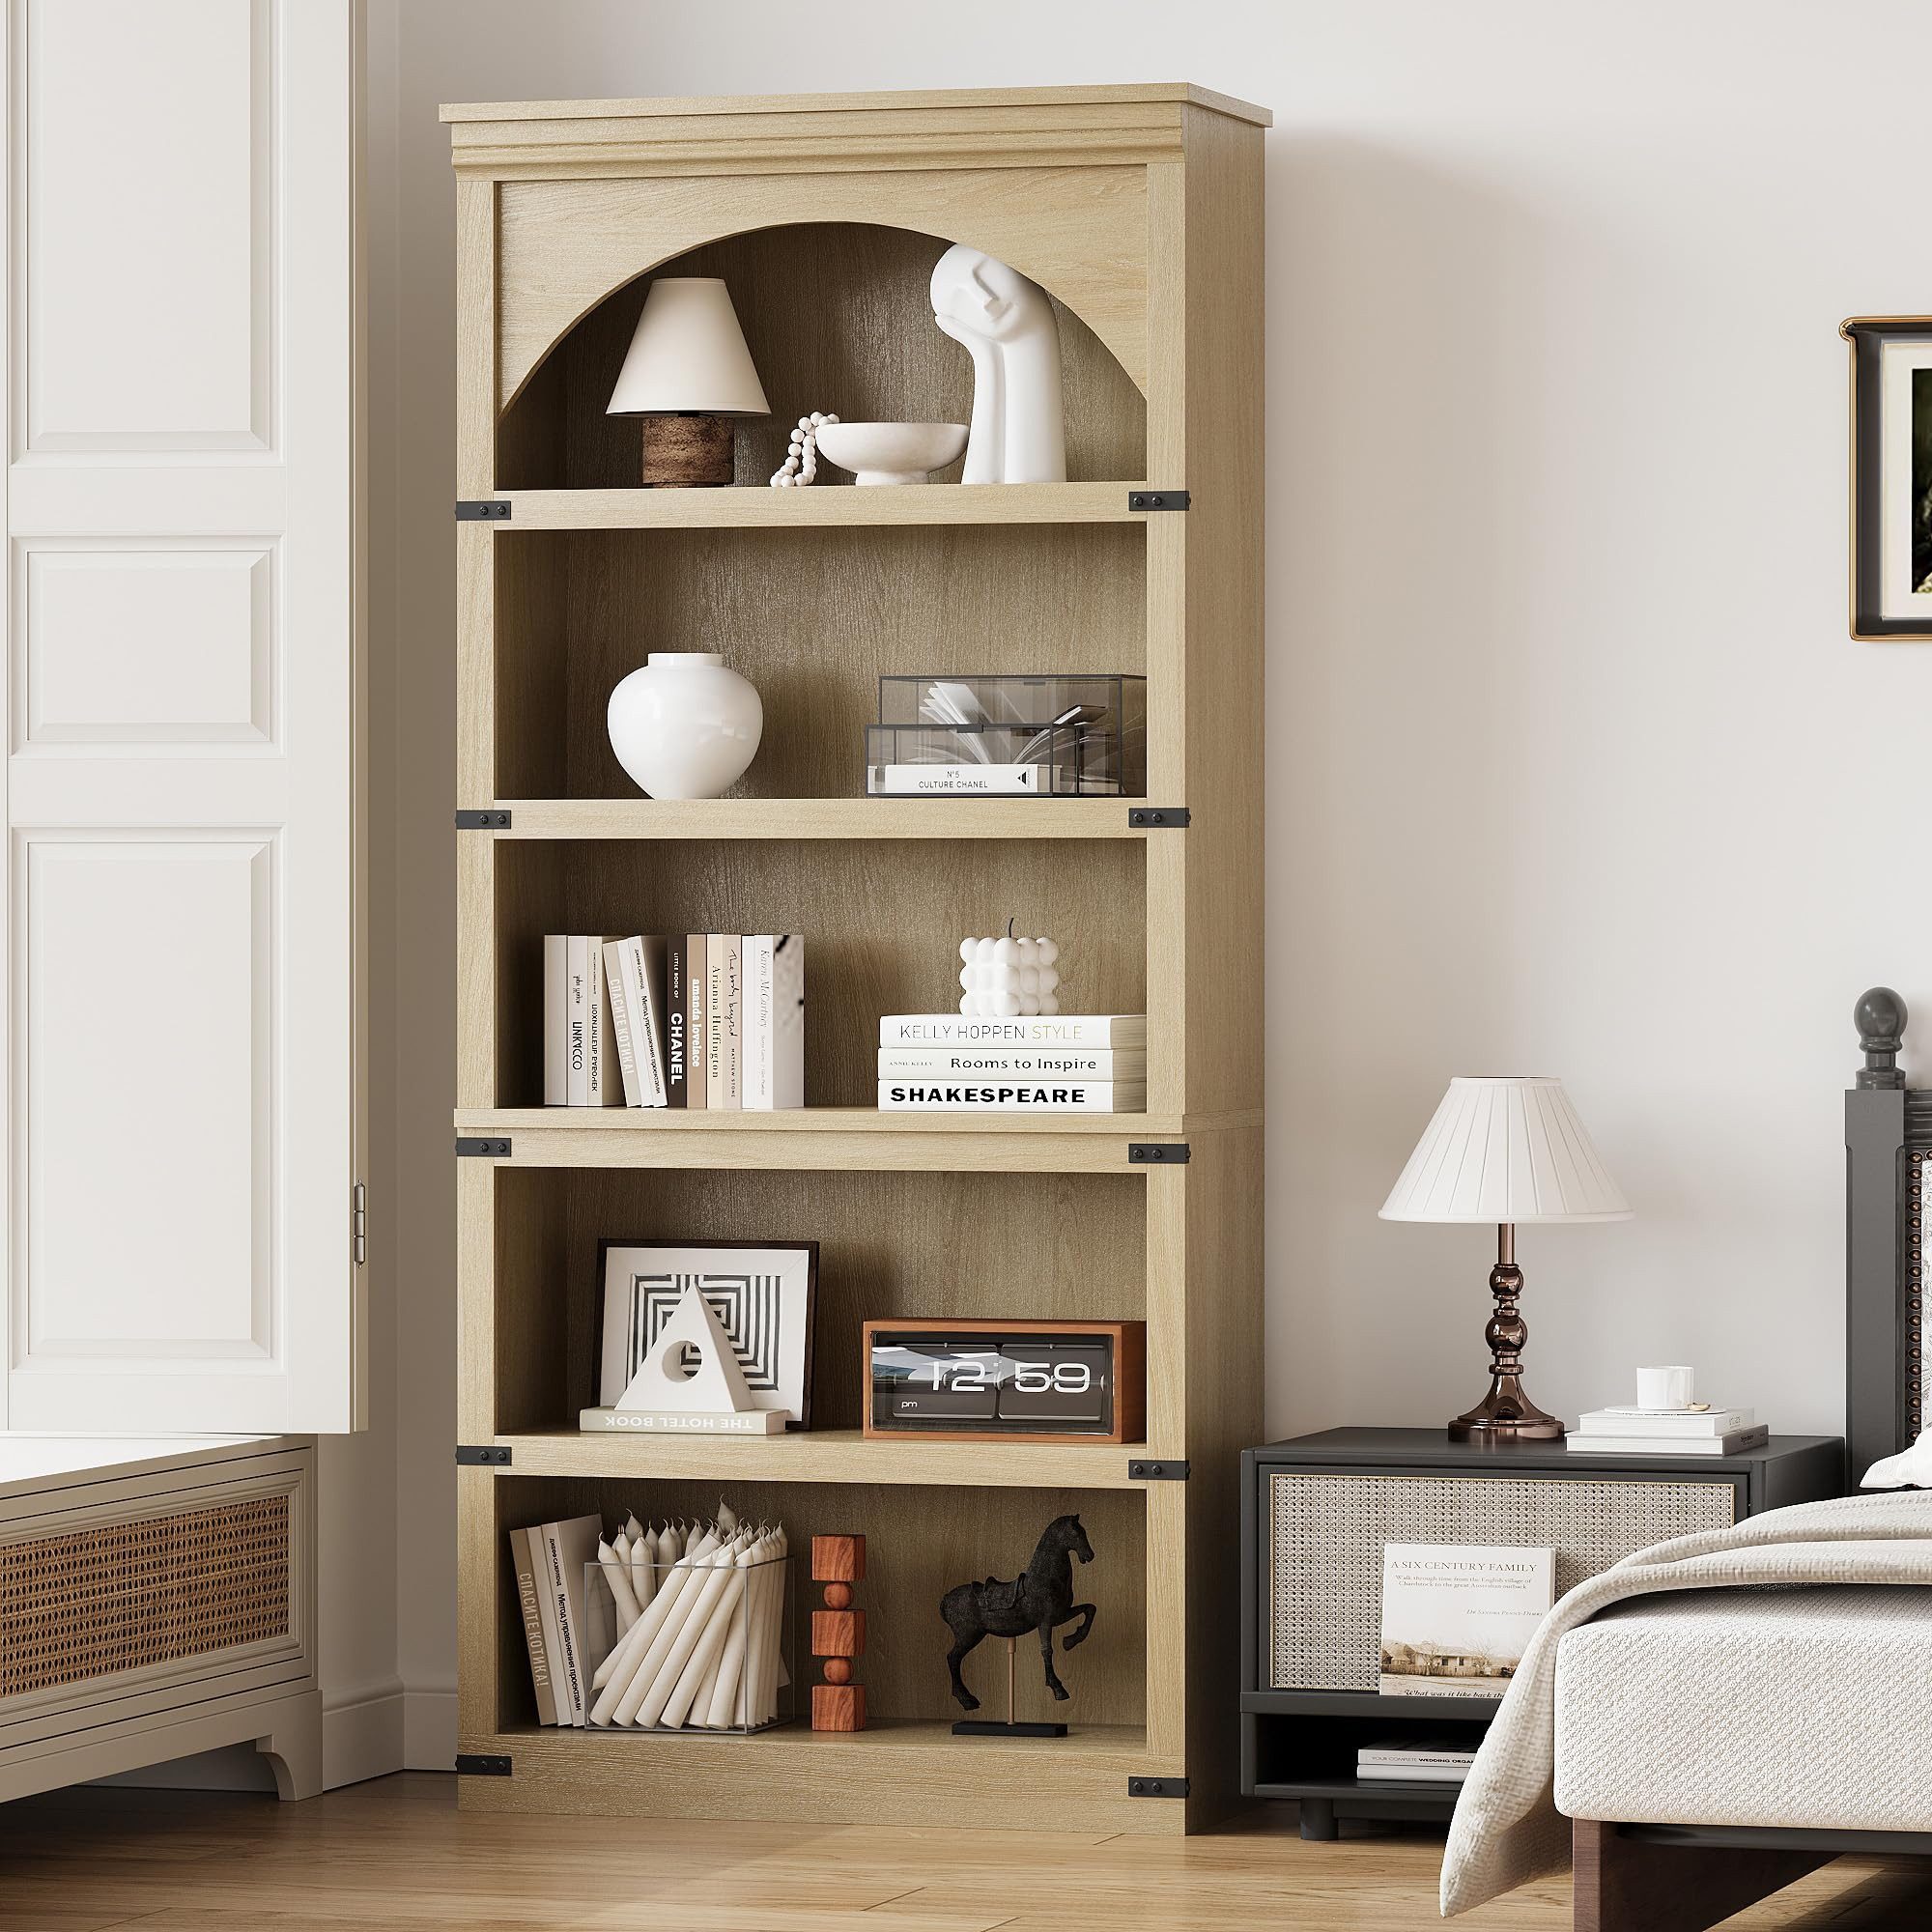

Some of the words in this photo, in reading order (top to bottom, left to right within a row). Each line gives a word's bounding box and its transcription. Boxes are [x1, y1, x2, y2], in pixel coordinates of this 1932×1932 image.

[919, 781, 953, 789] CULTURE
[957, 781, 988, 789] CHANEL
[728, 950, 738, 971] The
[759, 950, 770, 977] Karen
[673, 990, 679, 999] OF
[712, 966, 722, 1010] Arianna
[728, 974, 740, 997] body
[610, 979, 627, 1026] СПАСИТЕ
[640, 995, 650, 1017] Метод
[691, 979, 701, 1021] amanda
[757, 980, 770, 1029] McCartney
[724, 1002, 738, 1037] beyond
[900, 1024, 952, 1039] KELLY
[957, 1024, 1026, 1040] HOPPEN
[1032, 1025, 1083, 1040] STYLE
[617, 1029, 635, 1074] КОТИКА!
[671, 1012, 683, 1086] CHANEL
[691, 1024, 702, 1067] lovelace
[709, 1015, 722, 1079] Huffington
[951, 1058, 1009, 1069] Rooms
[1014, 1059, 1032, 1069] to
[1037, 1058, 1097, 1072] Inspire
[890, 1088, 1086, 1103] SHAKESPEARE
[932, 1360, 985, 1392] 12
[1014, 1362, 1092, 1393] 59
[901, 1401, 918, 1409] pm
[605, 1415, 653, 1428] BOOK
[659, 1417, 714, 1429] HOTEL
[720, 1418, 753, 1430] THE
[1402, 1561, 1422, 1570] SIX
[1424, 1562, 1488, 1571] CENTURY
[1489, 1563, 1538, 1573] FAMILY
[519, 1573, 540, 1629] СПАСИТЕ
[528, 1632, 549, 1687] КОТИКА!
[557, 1593, 568, 1618] Метод
[568, 1669, 582, 1712] проектами
